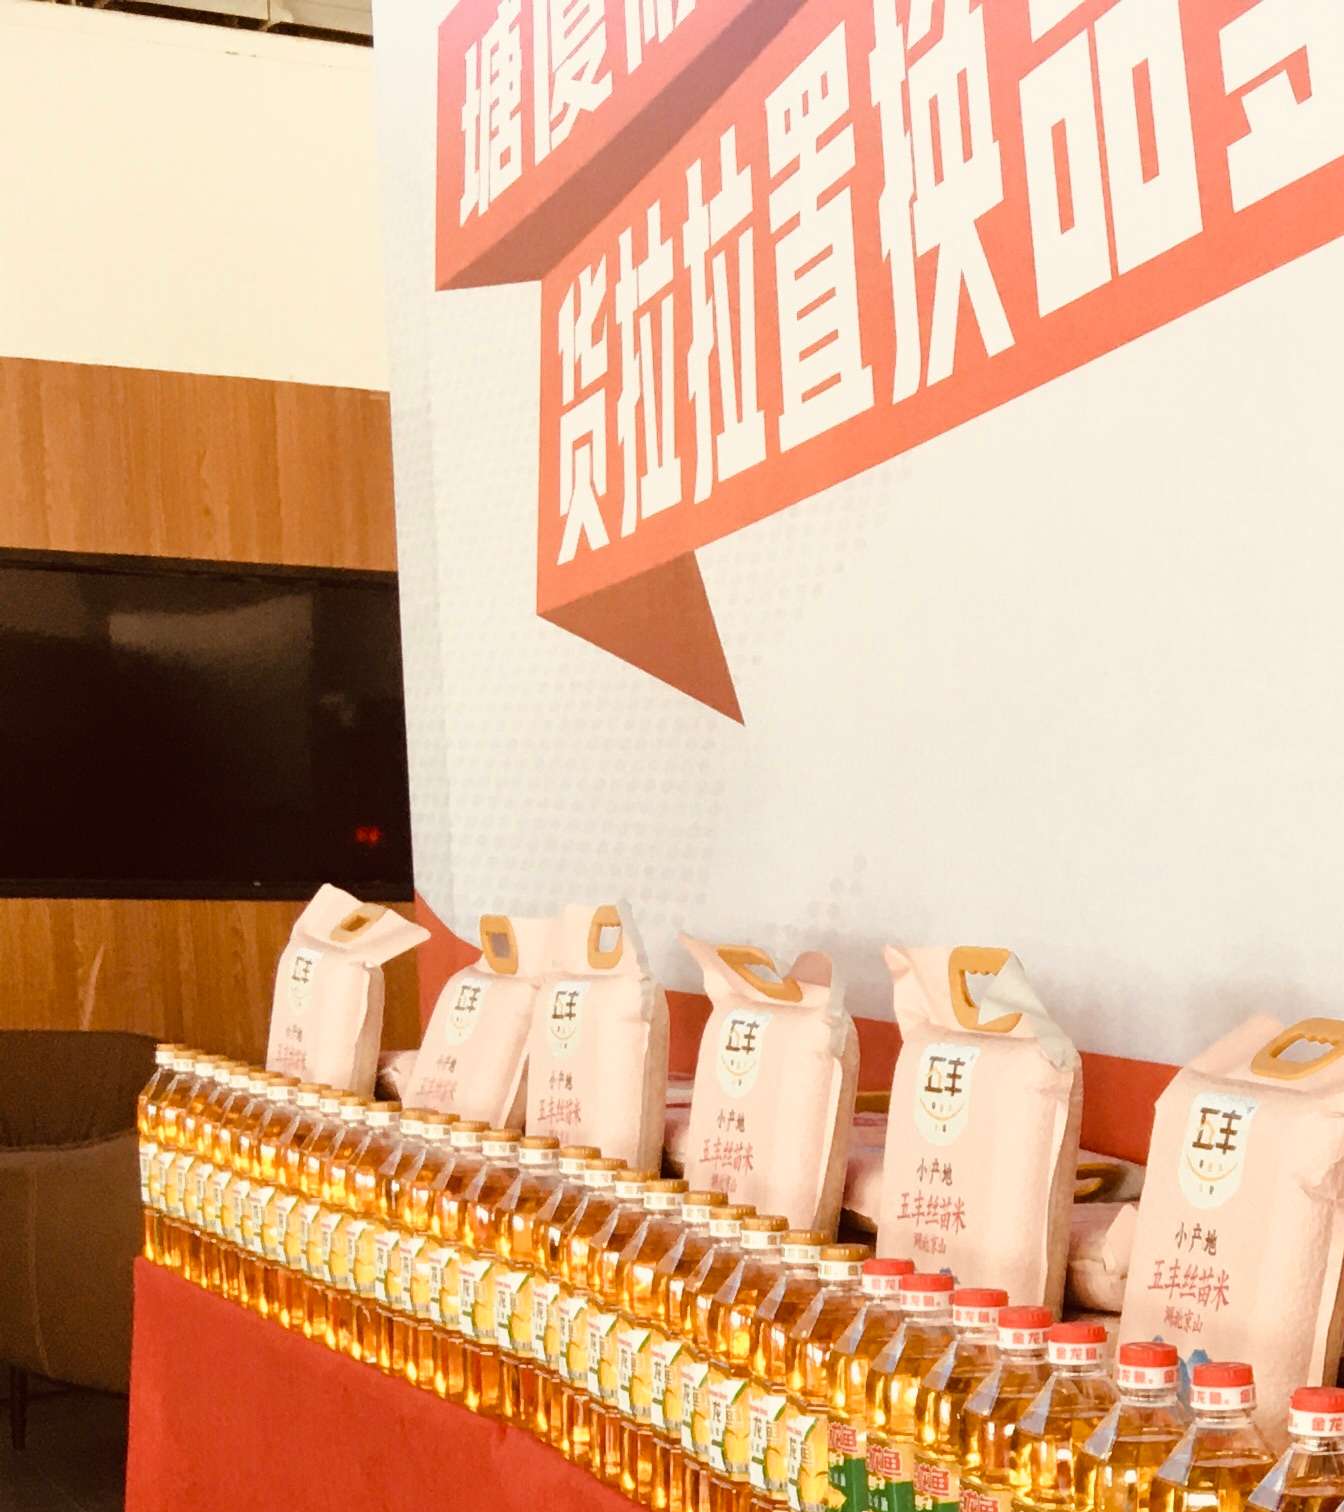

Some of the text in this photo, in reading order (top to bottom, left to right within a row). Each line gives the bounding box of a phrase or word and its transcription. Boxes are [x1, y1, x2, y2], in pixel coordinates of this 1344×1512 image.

[459, 0, 697, 228] 塘厦
[1175, 1221, 1217, 1256] 小产地
[1147, 1259, 1230, 1312] 五丰丝苗米
